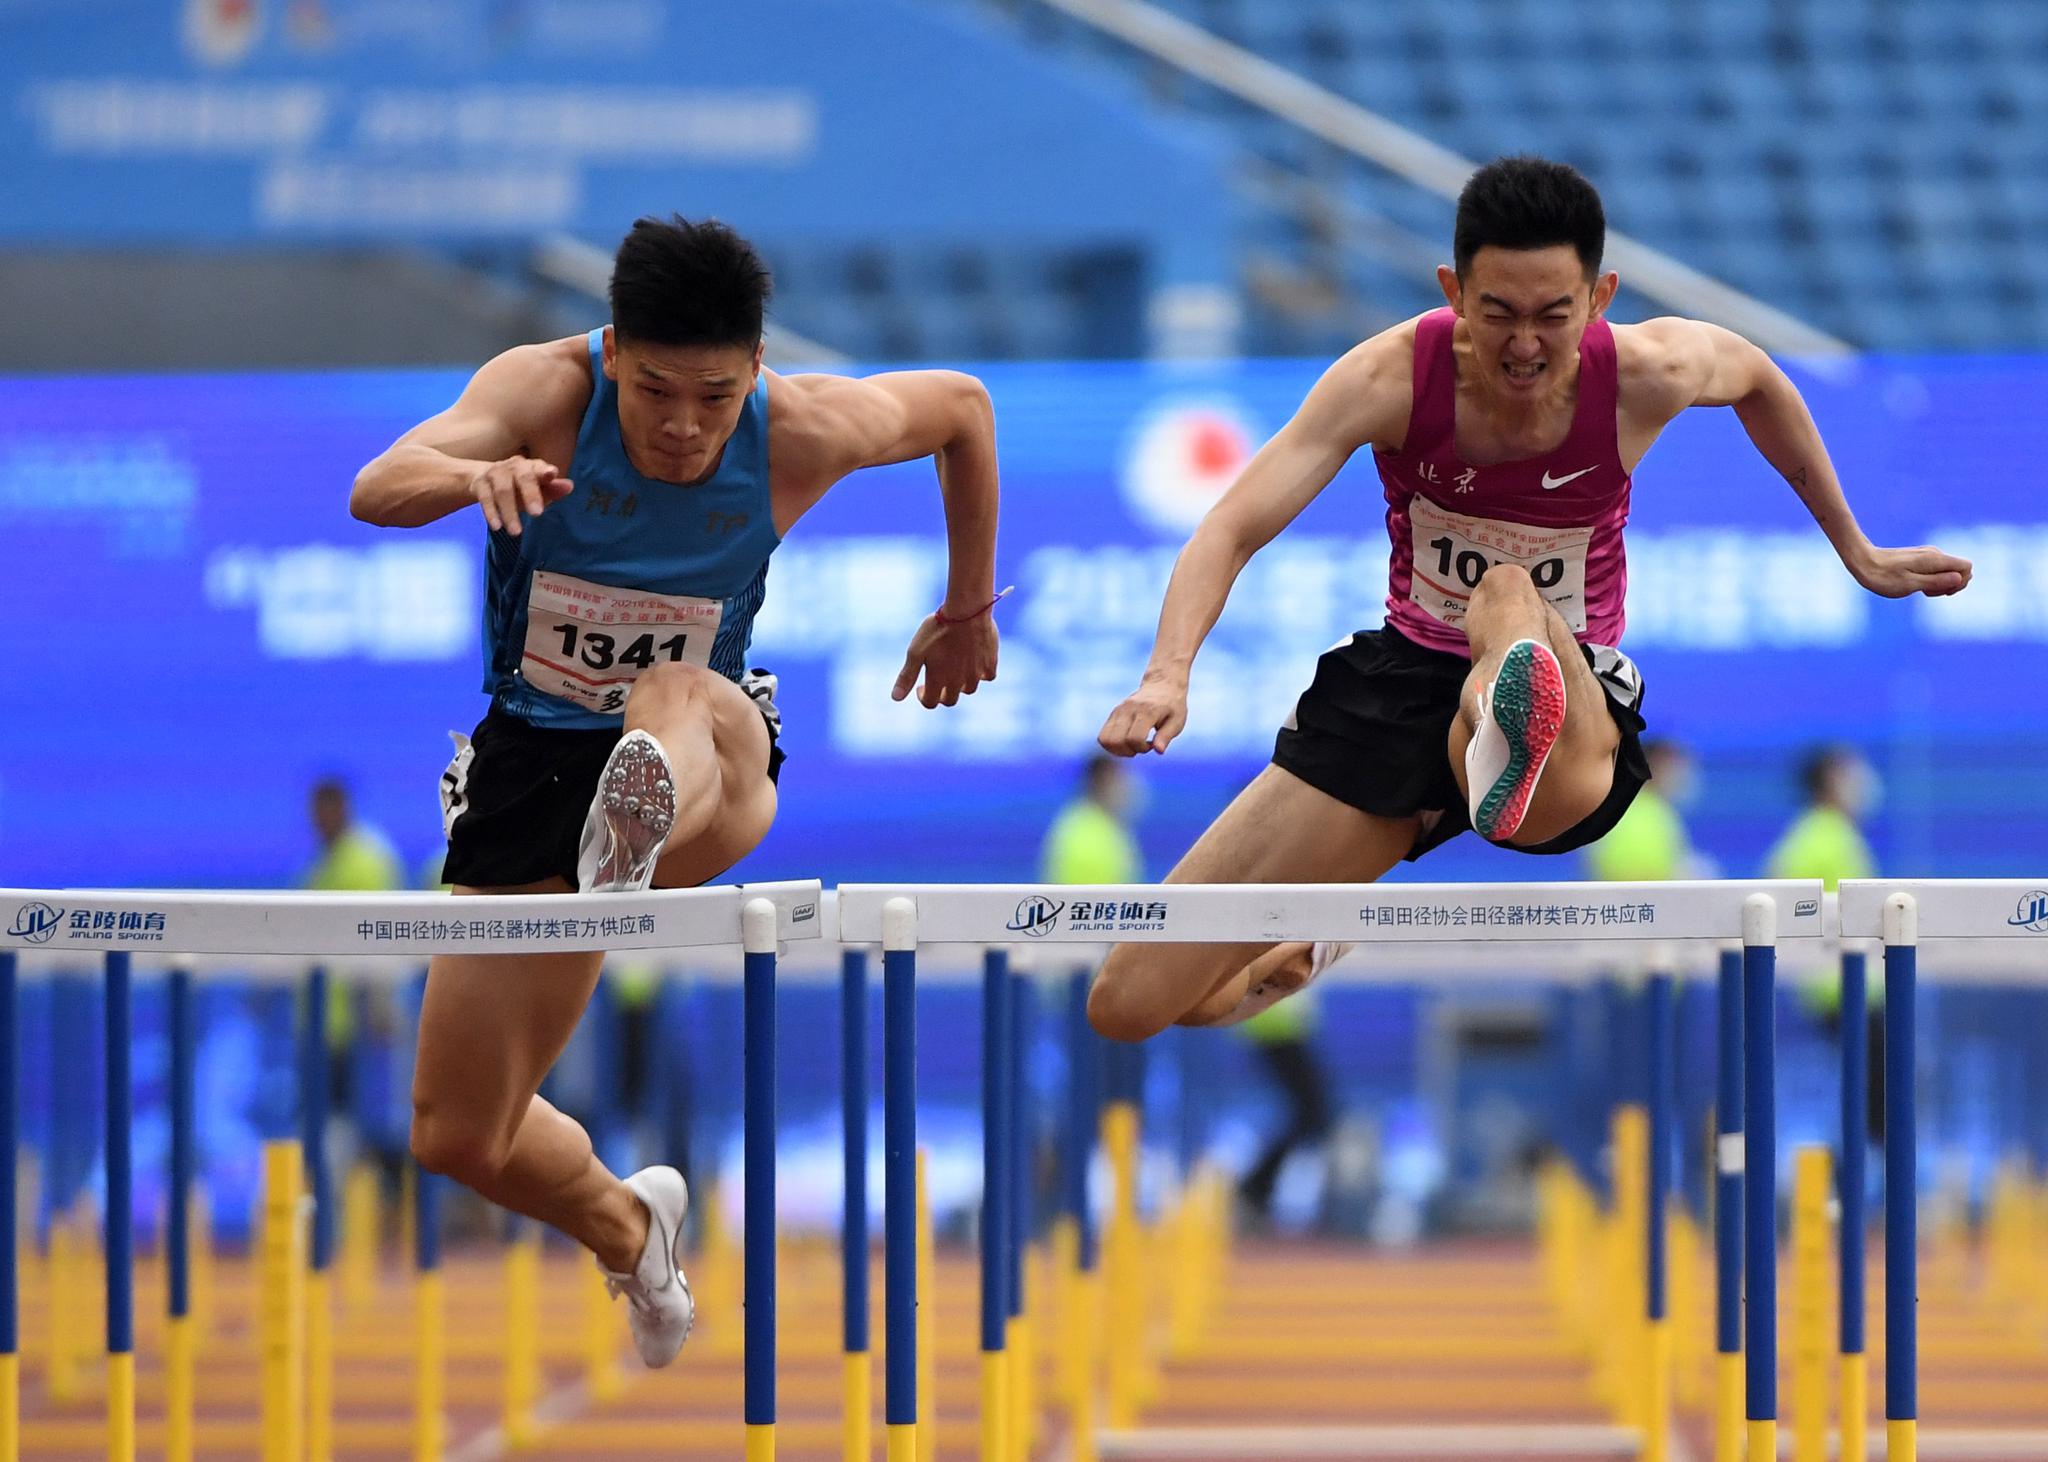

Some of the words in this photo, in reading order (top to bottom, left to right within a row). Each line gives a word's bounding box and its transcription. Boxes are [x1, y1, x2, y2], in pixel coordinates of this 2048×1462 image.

[1418, 461, 1477, 494] 北京
[1431, 536, 1563, 588] 100
[552, 623, 687, 670] 1341
[69, 909, 167, 931] 金陵体育
[1069, 902, 1168, 921] 金陵体育
[1359, 903, 1655, 927] 中国田径协会田径器材类官方供应商
[69, 931, 113, 940] JINLING
[117, 932, 164, 941] SPORTS
[357, 913, 656, 940] 中国田径协会田径器材类官方供应商
[1069, 923, 1113, 931] JINLING
[1118, 923, 1165, 931] SPORTS
